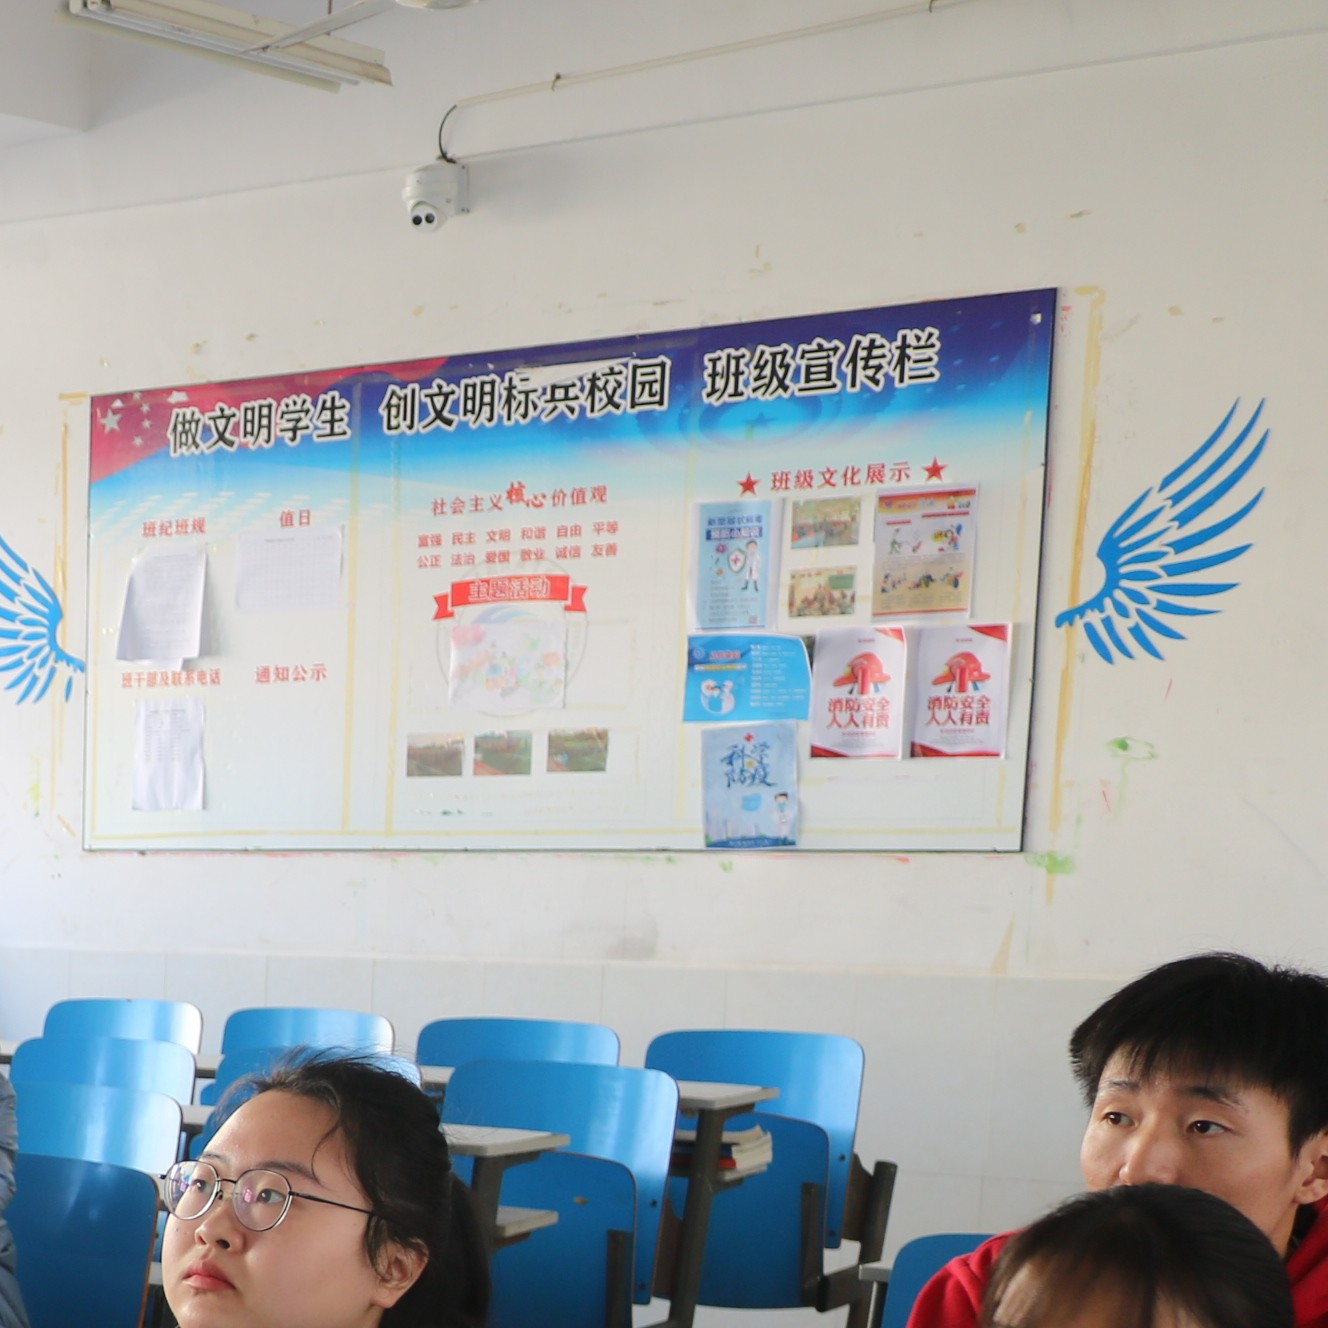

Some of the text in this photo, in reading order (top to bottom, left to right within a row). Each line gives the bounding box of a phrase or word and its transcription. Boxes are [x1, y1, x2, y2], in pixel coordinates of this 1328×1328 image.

[168, 328, 940, 456] 做文明学生 创文明标兵校园 班级宣传栏
[770, 461, 911, 492] 班级文化展示
[432, 481, 607, 516] 社会主义核心价值观
[142, 516, 207, 538] 班纪班规
[280, 509, 311, 528] 值日
[418, 521, 619, 548] 富强 民主 文明 和谐 自由 平等
[417, 543, 618, 569] 公正 法治 爱国 敬业 诚信 友善
[468, 577, 551, 602] 主题活动
[121, 668, 222, 689] 班干部及联系电话
[255, 663, 327, 684] 通知公示
[828, 696, 891, 713] 消防安全
[928, 694, 992, 711] 消防安全
[826, 711, 890, 729] 人人有责
[926, 710, 990, 726] 人人有责
